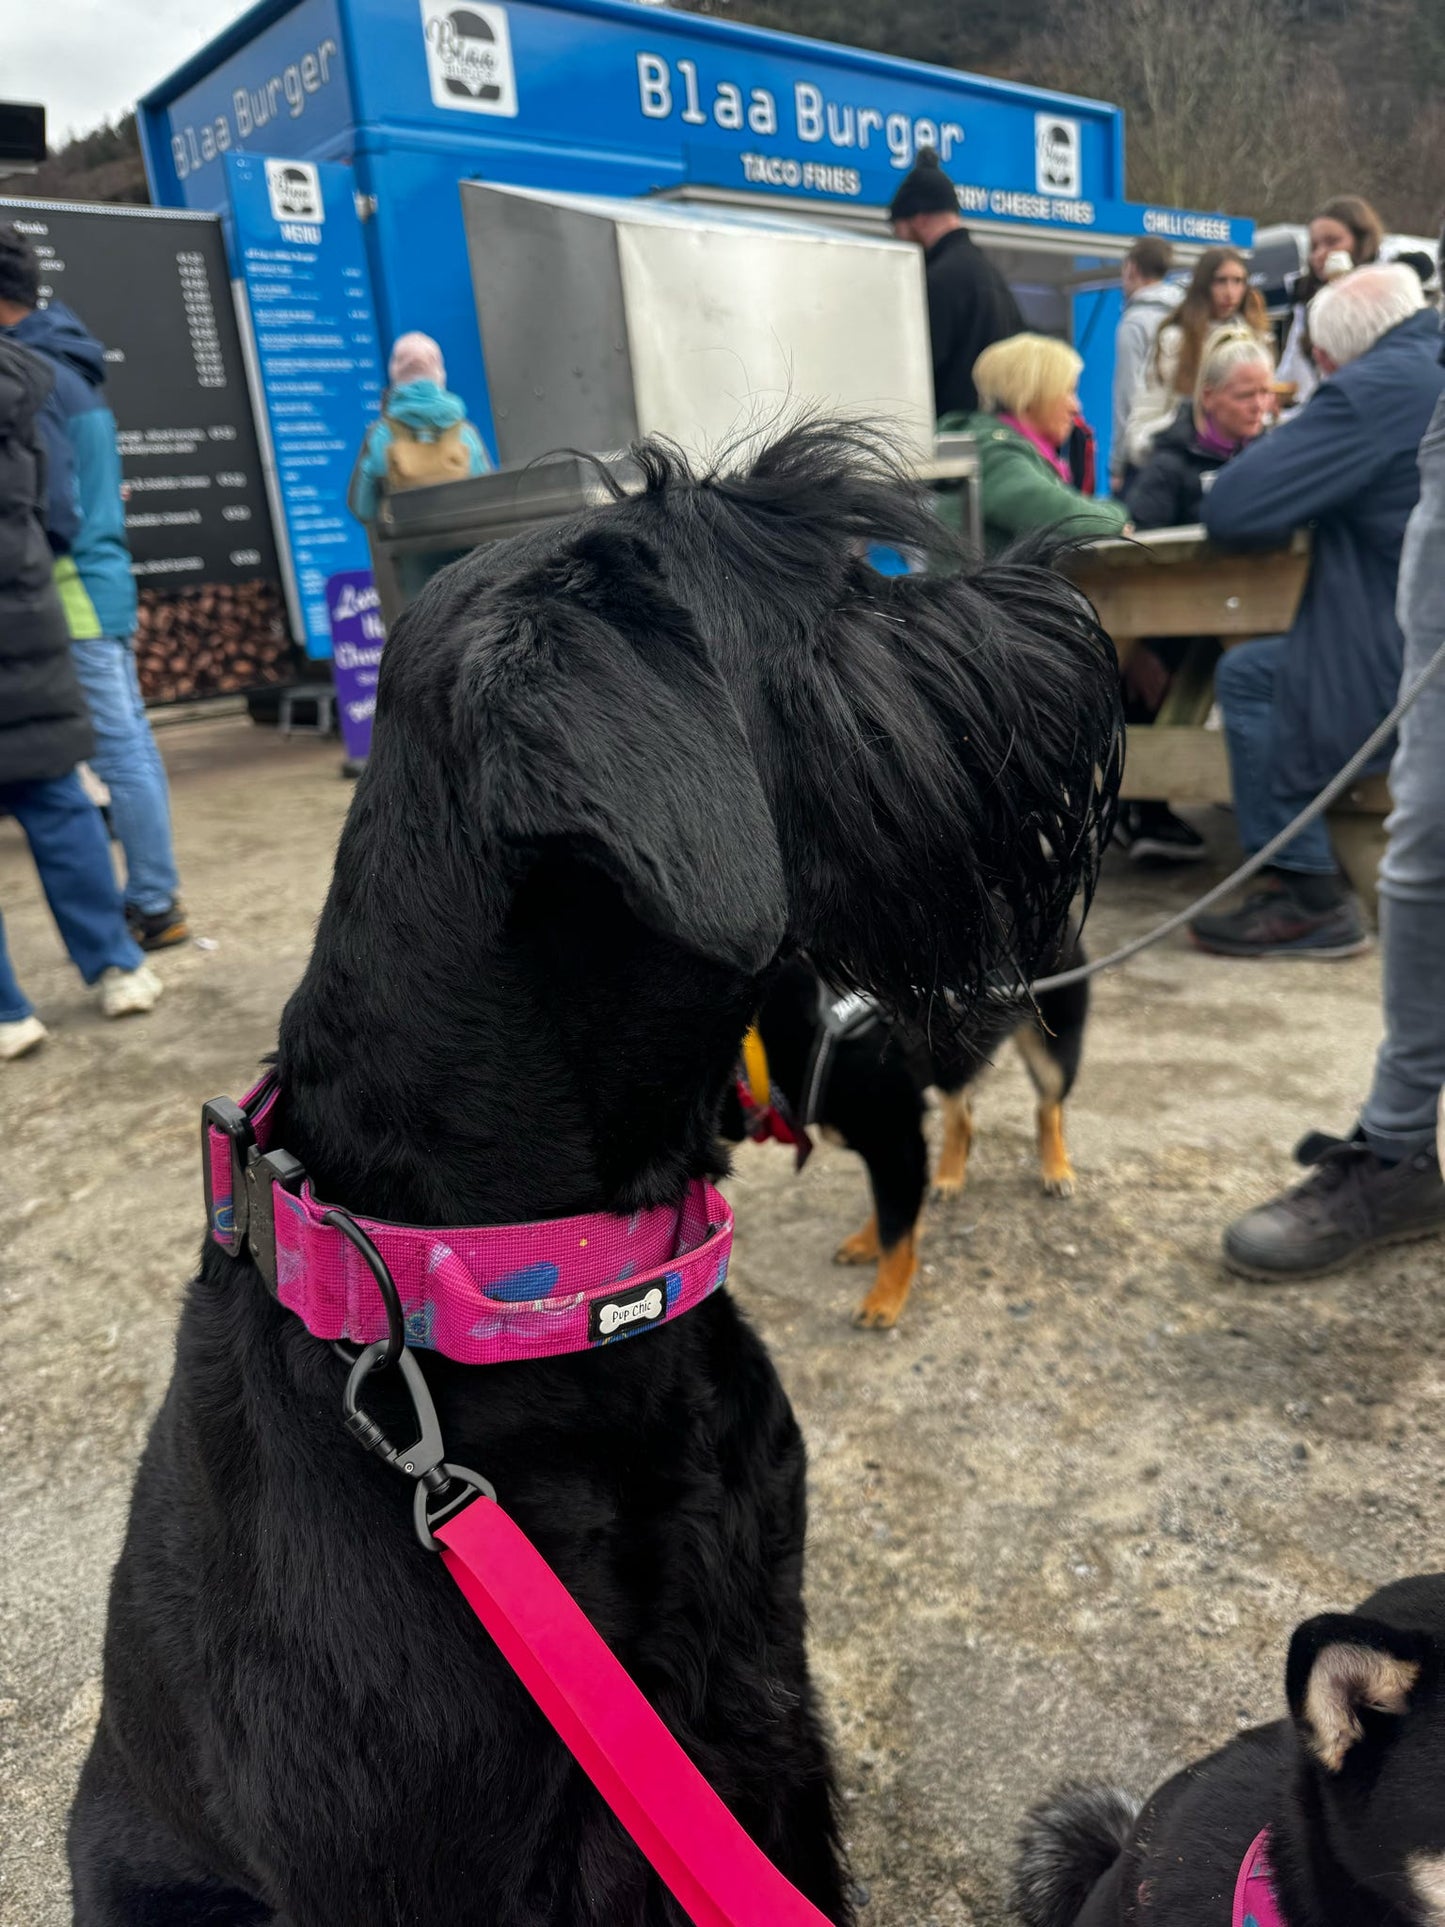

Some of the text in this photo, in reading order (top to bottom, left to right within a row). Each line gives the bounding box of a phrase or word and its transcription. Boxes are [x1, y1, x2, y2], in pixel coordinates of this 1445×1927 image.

[172, 40, 336, 179] Blaa Burger
[636, 51, 777, 136] Blaa
[793, 80, 965, 170] Burger
[740, 151, 862, 197] TACO FRIES
[990, 190, 1051, 220] CHEESE
[1051, 200, 1096, 226] FRIES
[1142, 208, 1231, 242] CHILLI CHEESE
[280, 223, 322, 246] MENU
[632, 1300, 652, 1316] Chic
